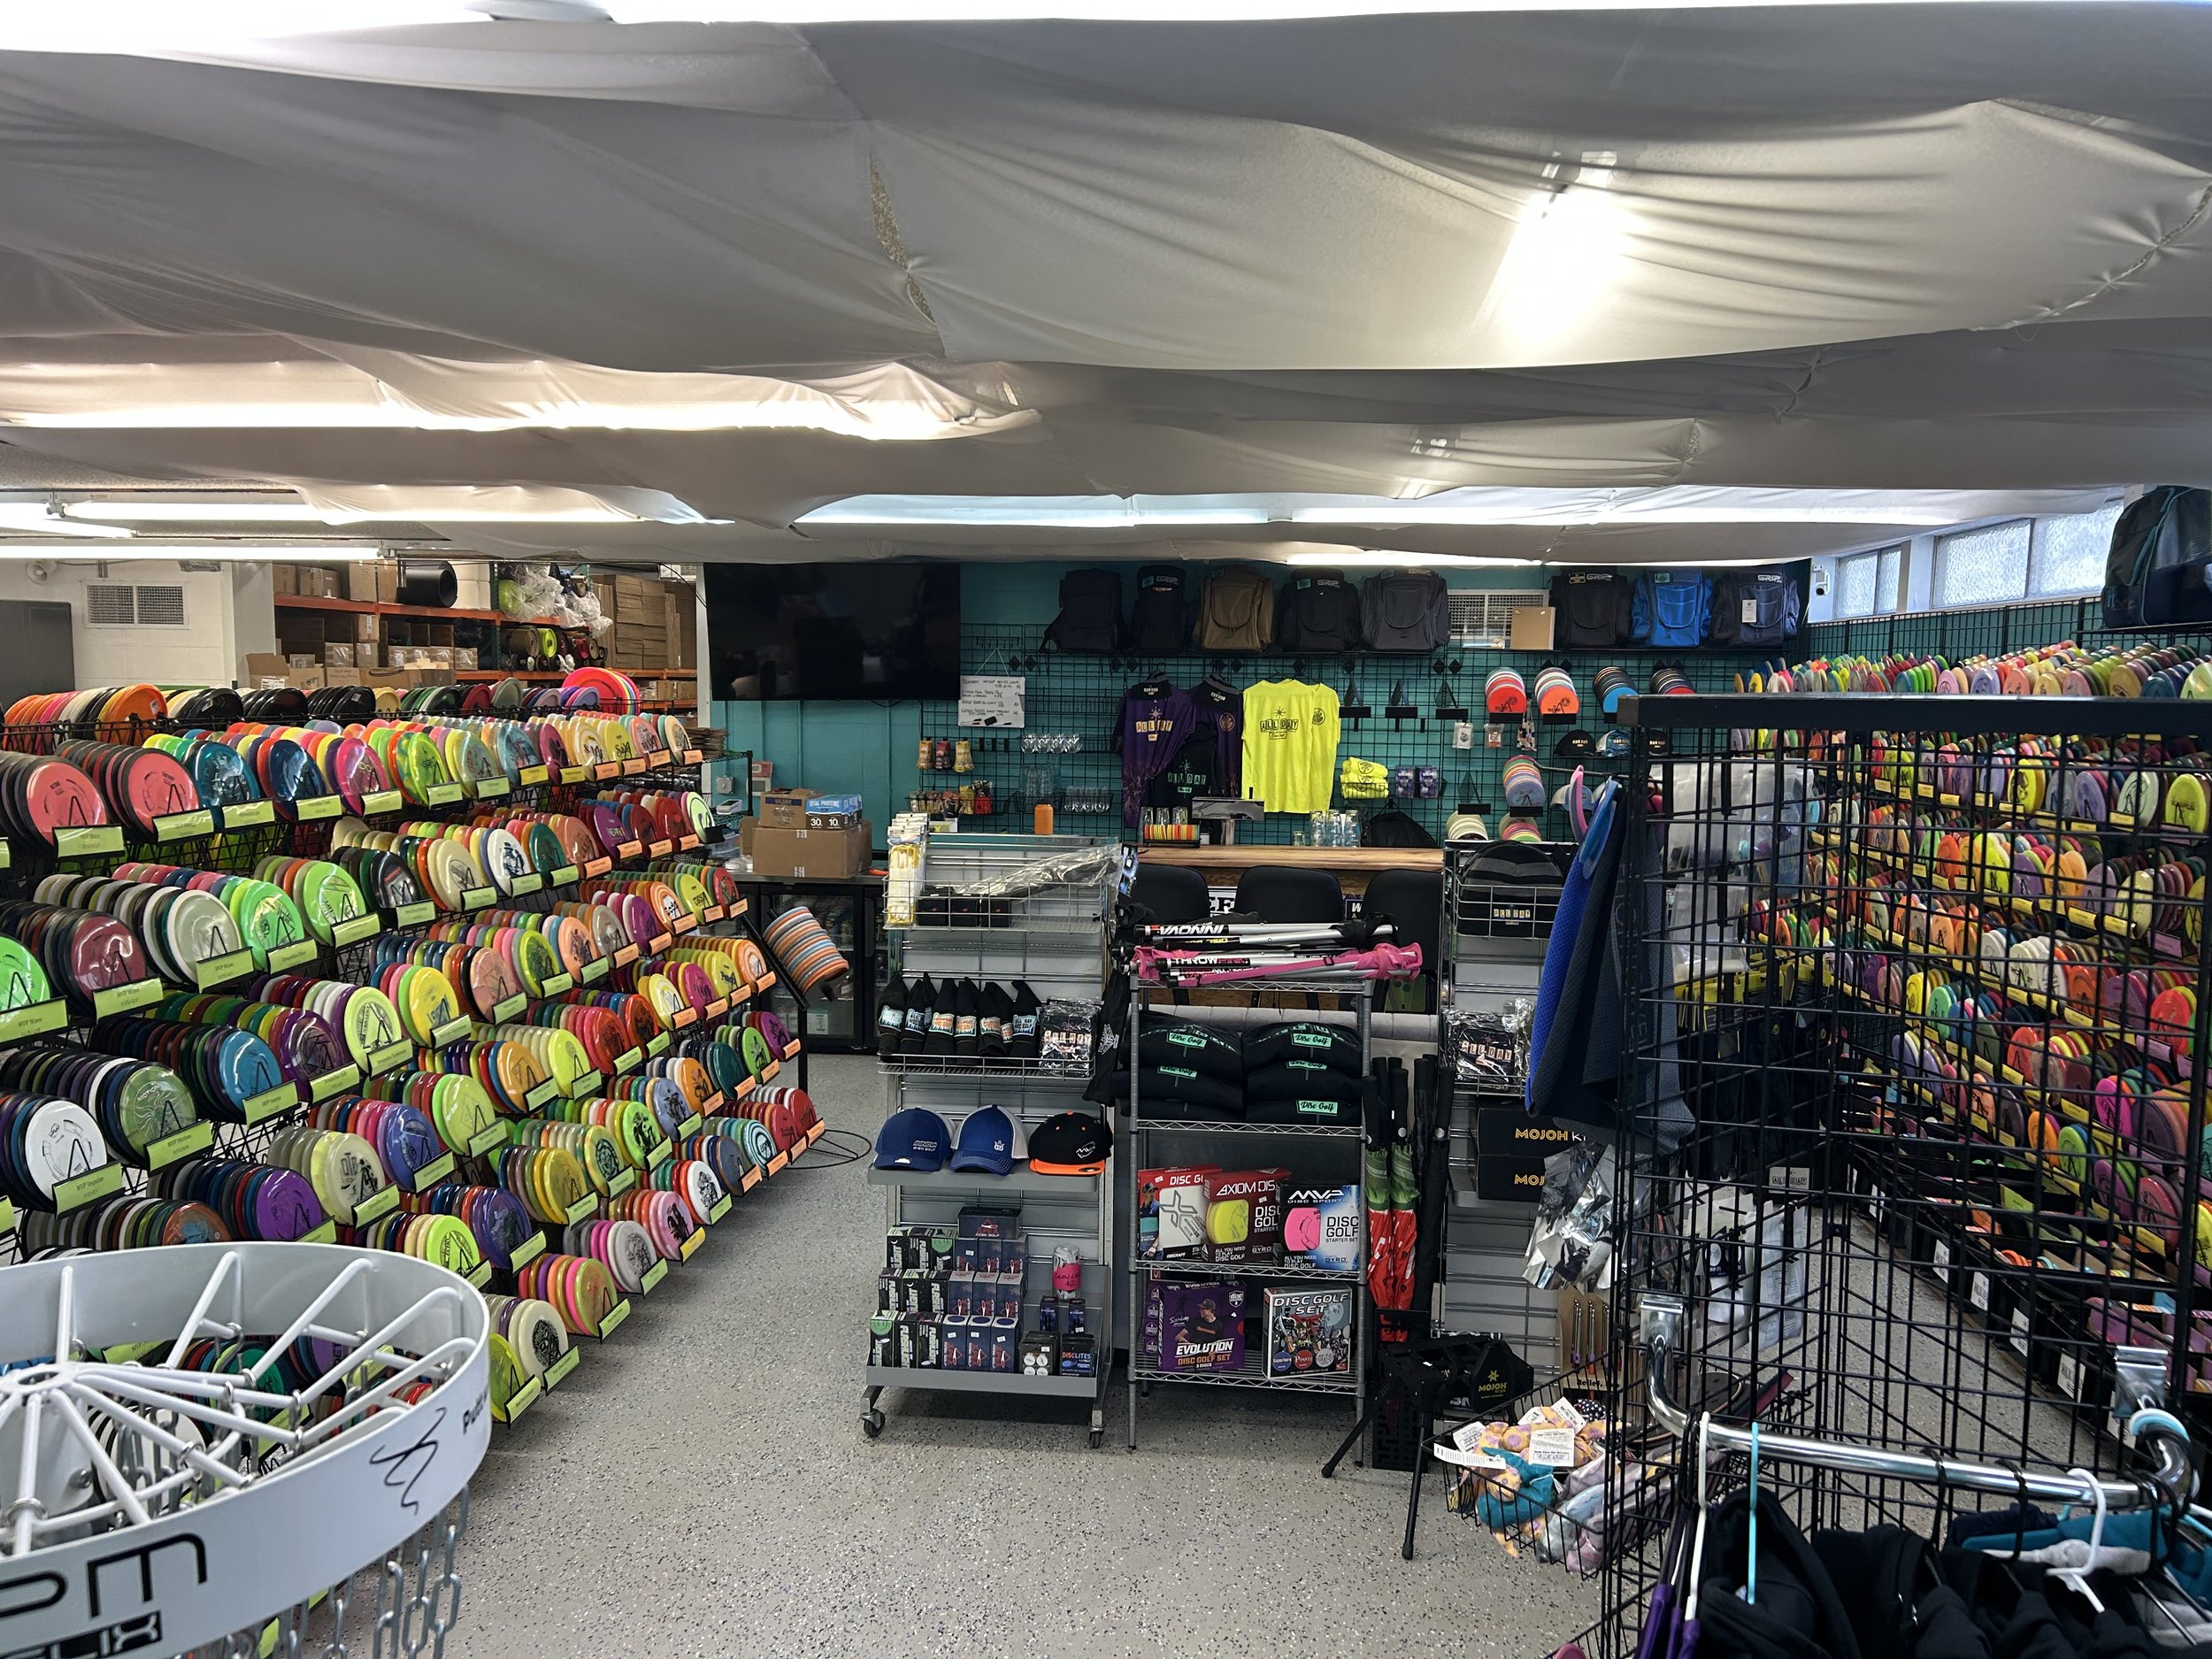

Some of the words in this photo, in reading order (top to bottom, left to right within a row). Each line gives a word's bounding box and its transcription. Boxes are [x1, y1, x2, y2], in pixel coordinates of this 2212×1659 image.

[1280, 718, 1299, 731] DAY
[1160, 924, 1225, 935] INNOVA
[18, 1018, 28, 1027] MVP
[29, 1018, 42, 1026] Wave
[1171, 1033, 1187, 1042] Disc
[1188, 1036, 1203, 1046] Golf
[1295, 1033, 1311, 1042] Disc
[1313, 1035, 1329, 1045] Golf
[1488, 1046, 1512, 1061] DAY
[1300, 1101, 1317, 1110] Disc
[1318, 1102, 1334, 1111] Golf
[1515, 1128, 1568, 1141] MOJOH
[912, 1140, 938, 1148] INNOVA
[1169, 1174, 1192, 1186] DISC
[1514, 1173, 1545, 1187] MOJ
[76, 1182, 87, 1192] MVP
[1216, 1181, 1256, 1196] AXIOM
[1257, 1179, 1276, 1193] DIS
[1288, 1190, 1345, 1200] MVP
[1254, 1217, 1278, 1228] GOL
[1327, 1217, 1359, 1227] DISC
[1326, 1227, 1358, 1238] GOLF
[1274, 1295, 1310, 1307] DISC
[1313, 1293, 1348, 1304] GOLF
[1295, 1304, 1327, 1315] SET
[1176, 1340, 1233, 1356] EVOLUTION
[1178, 1356, 1195, 1365] DISC
[1196, 1355, 1216, 1363] GOLF
[1479, 1382, 1507, 1393] MOJOH
